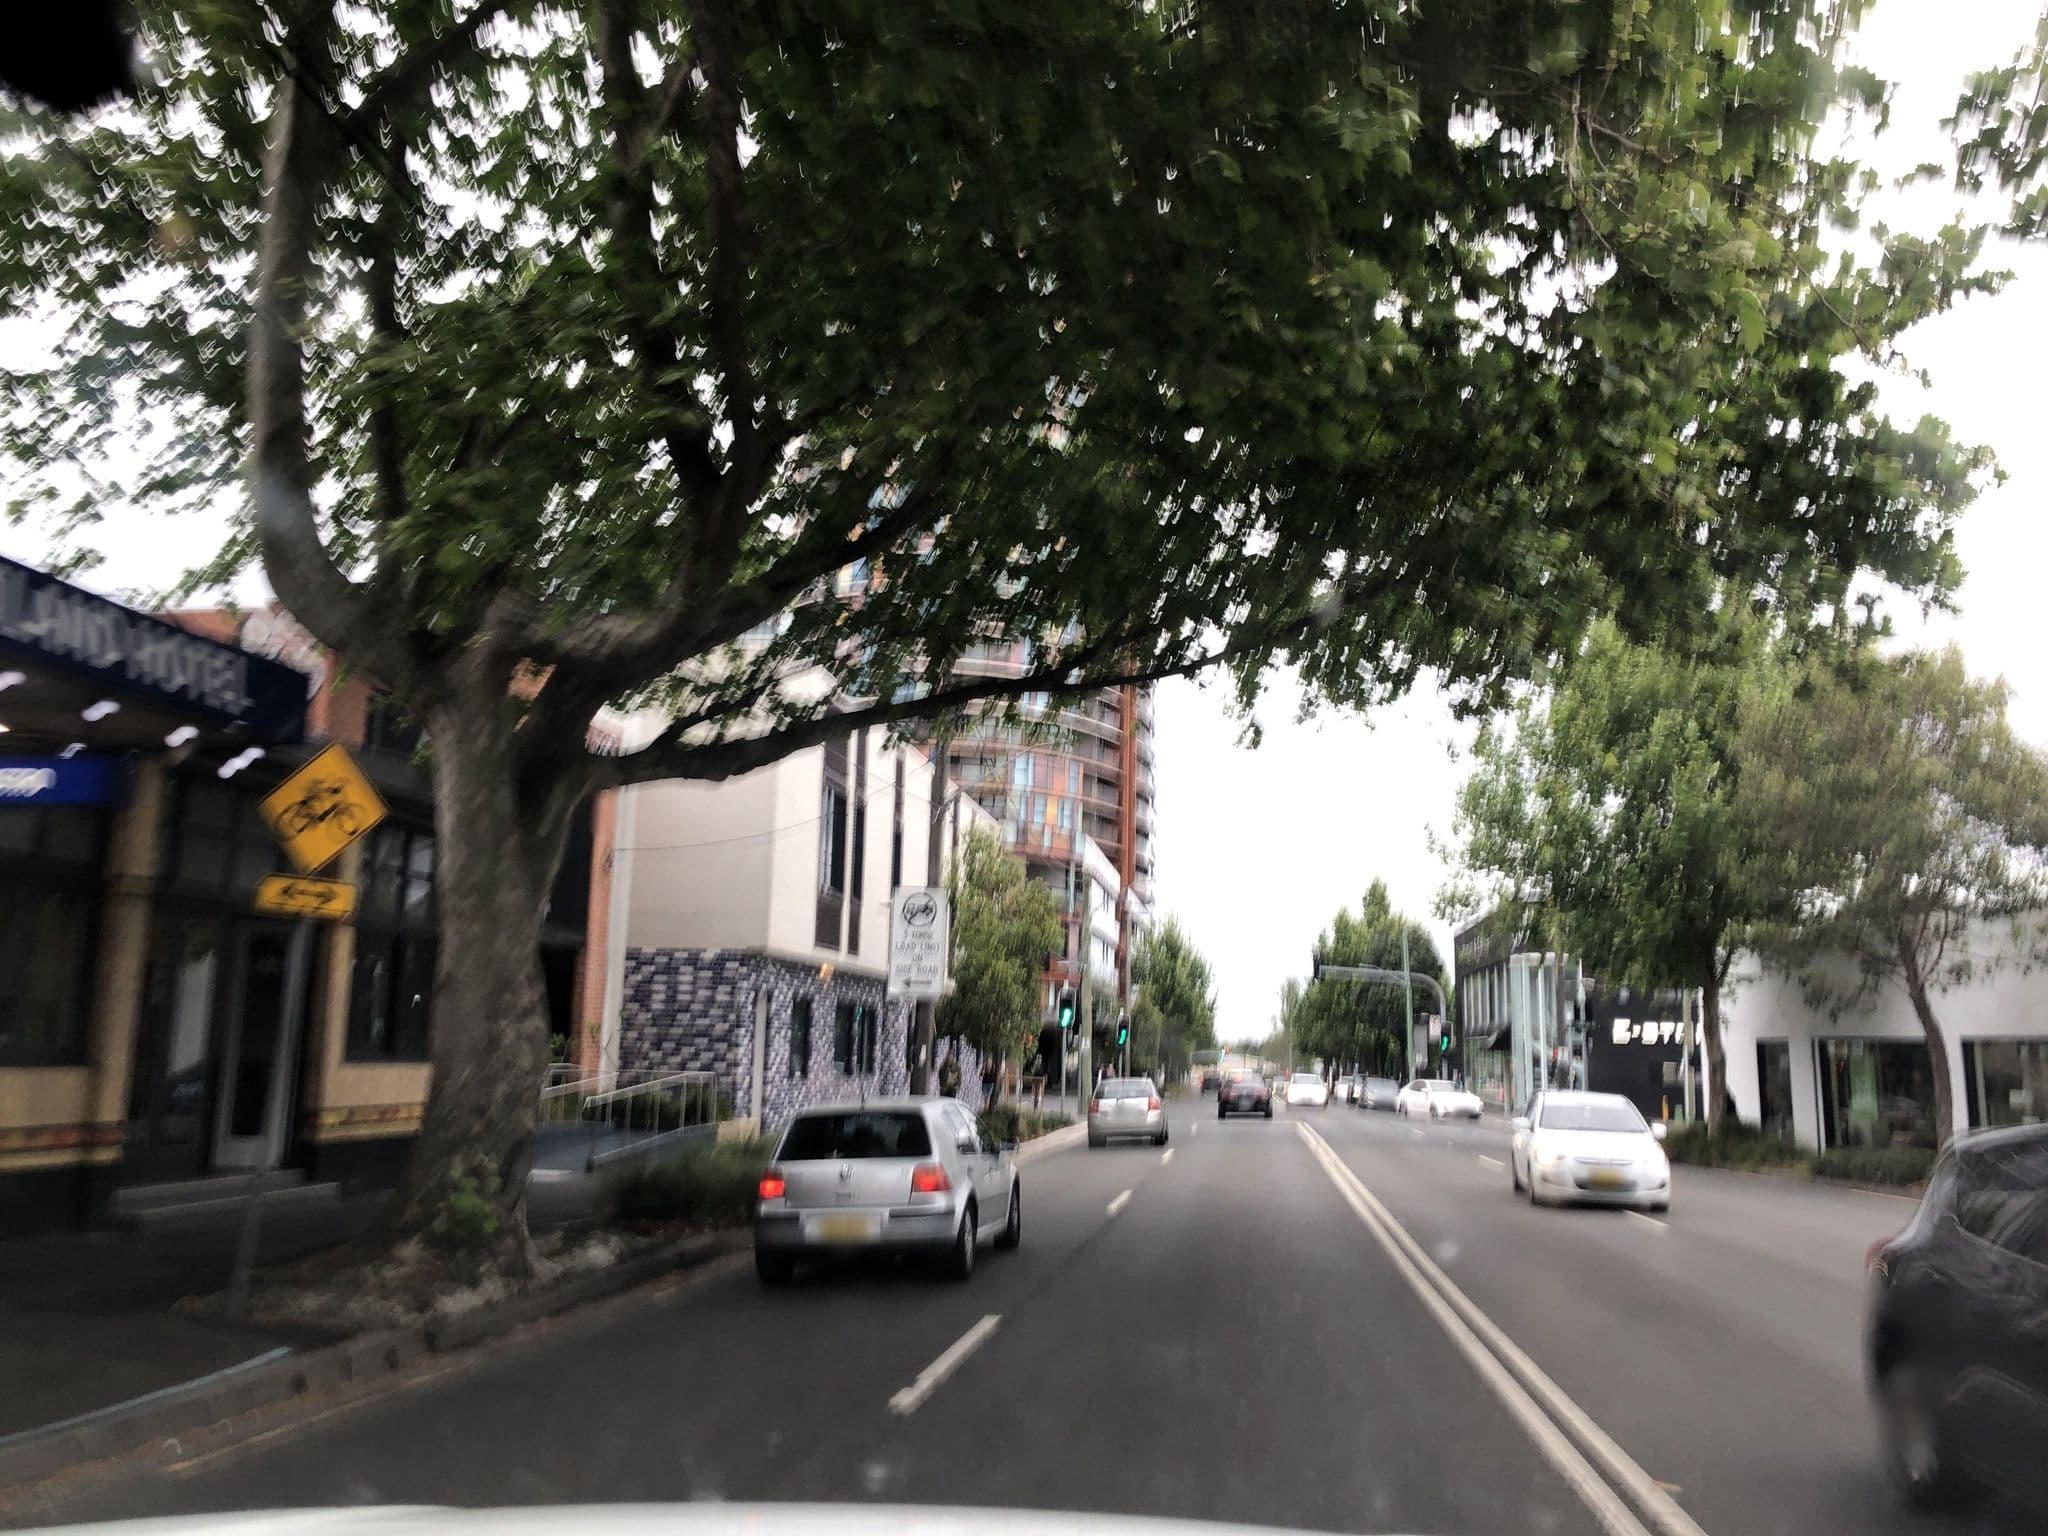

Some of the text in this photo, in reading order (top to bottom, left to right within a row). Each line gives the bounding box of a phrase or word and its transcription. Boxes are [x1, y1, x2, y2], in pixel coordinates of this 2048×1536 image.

[895, 941, 940, 951] LOAD LIMIT
[912, 953, 923, 962] ON
[895, 964, 939, 974] SIDE ROAD
